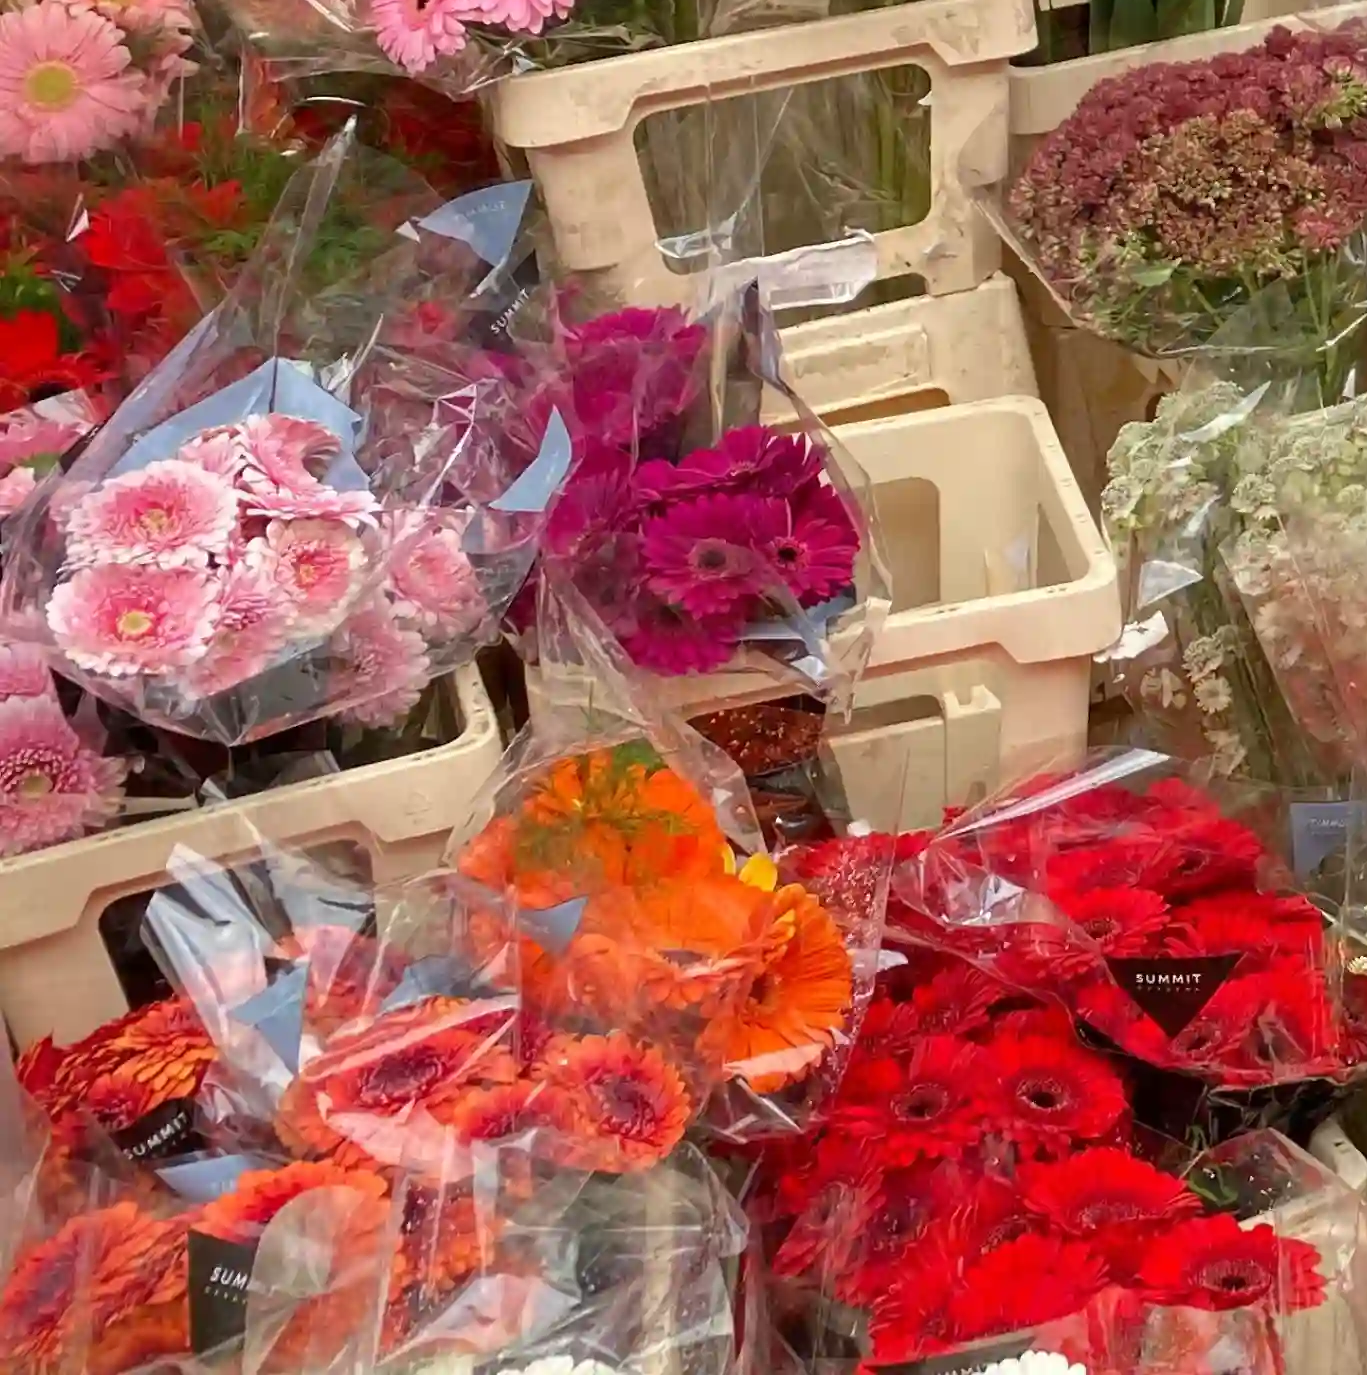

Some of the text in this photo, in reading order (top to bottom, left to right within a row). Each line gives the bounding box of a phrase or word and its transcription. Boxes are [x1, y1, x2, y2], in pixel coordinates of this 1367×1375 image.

[489, 287, 530, 335] SUMMIT
[1135, 972, 1202, 985] SUMMIT
[122, 1110, 187, 1161] SUMMIT
